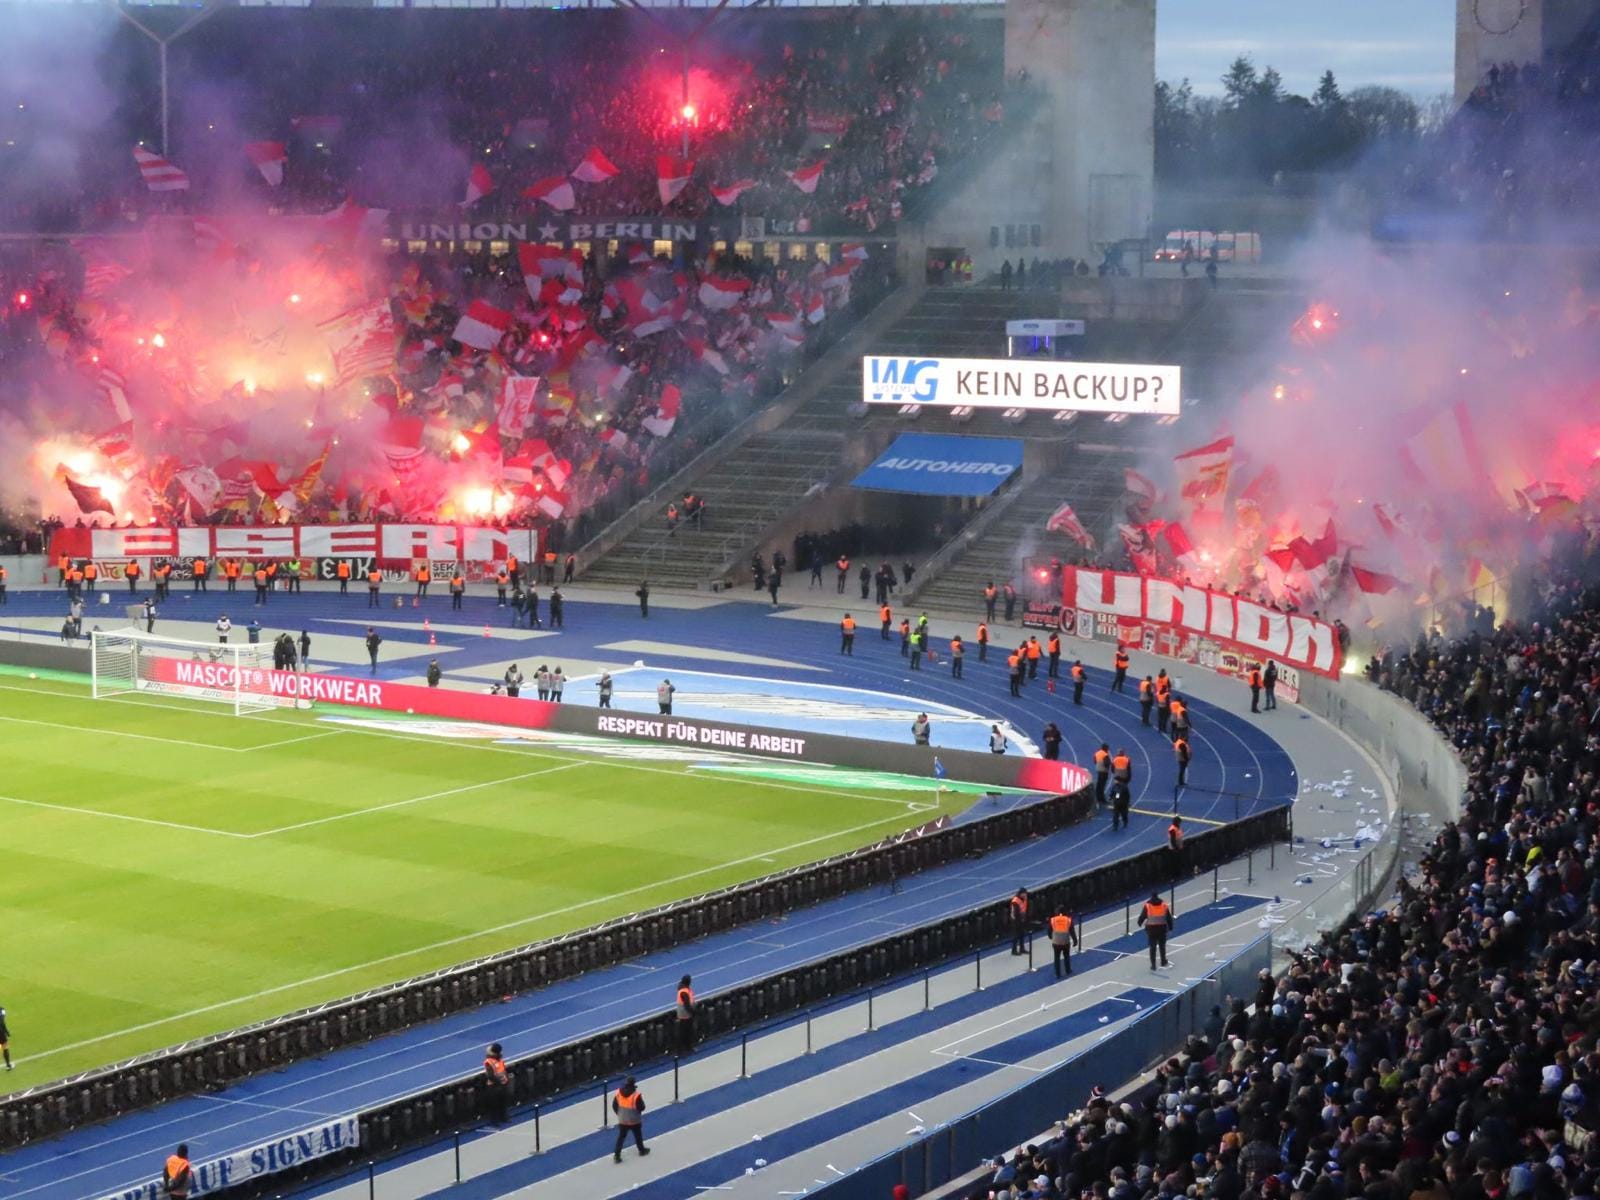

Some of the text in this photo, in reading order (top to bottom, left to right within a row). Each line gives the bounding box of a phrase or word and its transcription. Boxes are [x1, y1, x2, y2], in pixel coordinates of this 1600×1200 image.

[402, 222, 697, 240] UNION BERLIN
[956, 370, 1022, 397] KEIN
[1034, 373, 1164, 402] BACKUP?
[876, 457, 1015, 475] AUTOHERO
[1076, 569, 1334, 672] UNION
[268, 672, 382, 705] WORKWEAR
[598, 715, 806, 754] RESPEKT FÜR DEINE ARBEIT
[251, 1119, 356, 1174] SIGNAL!
